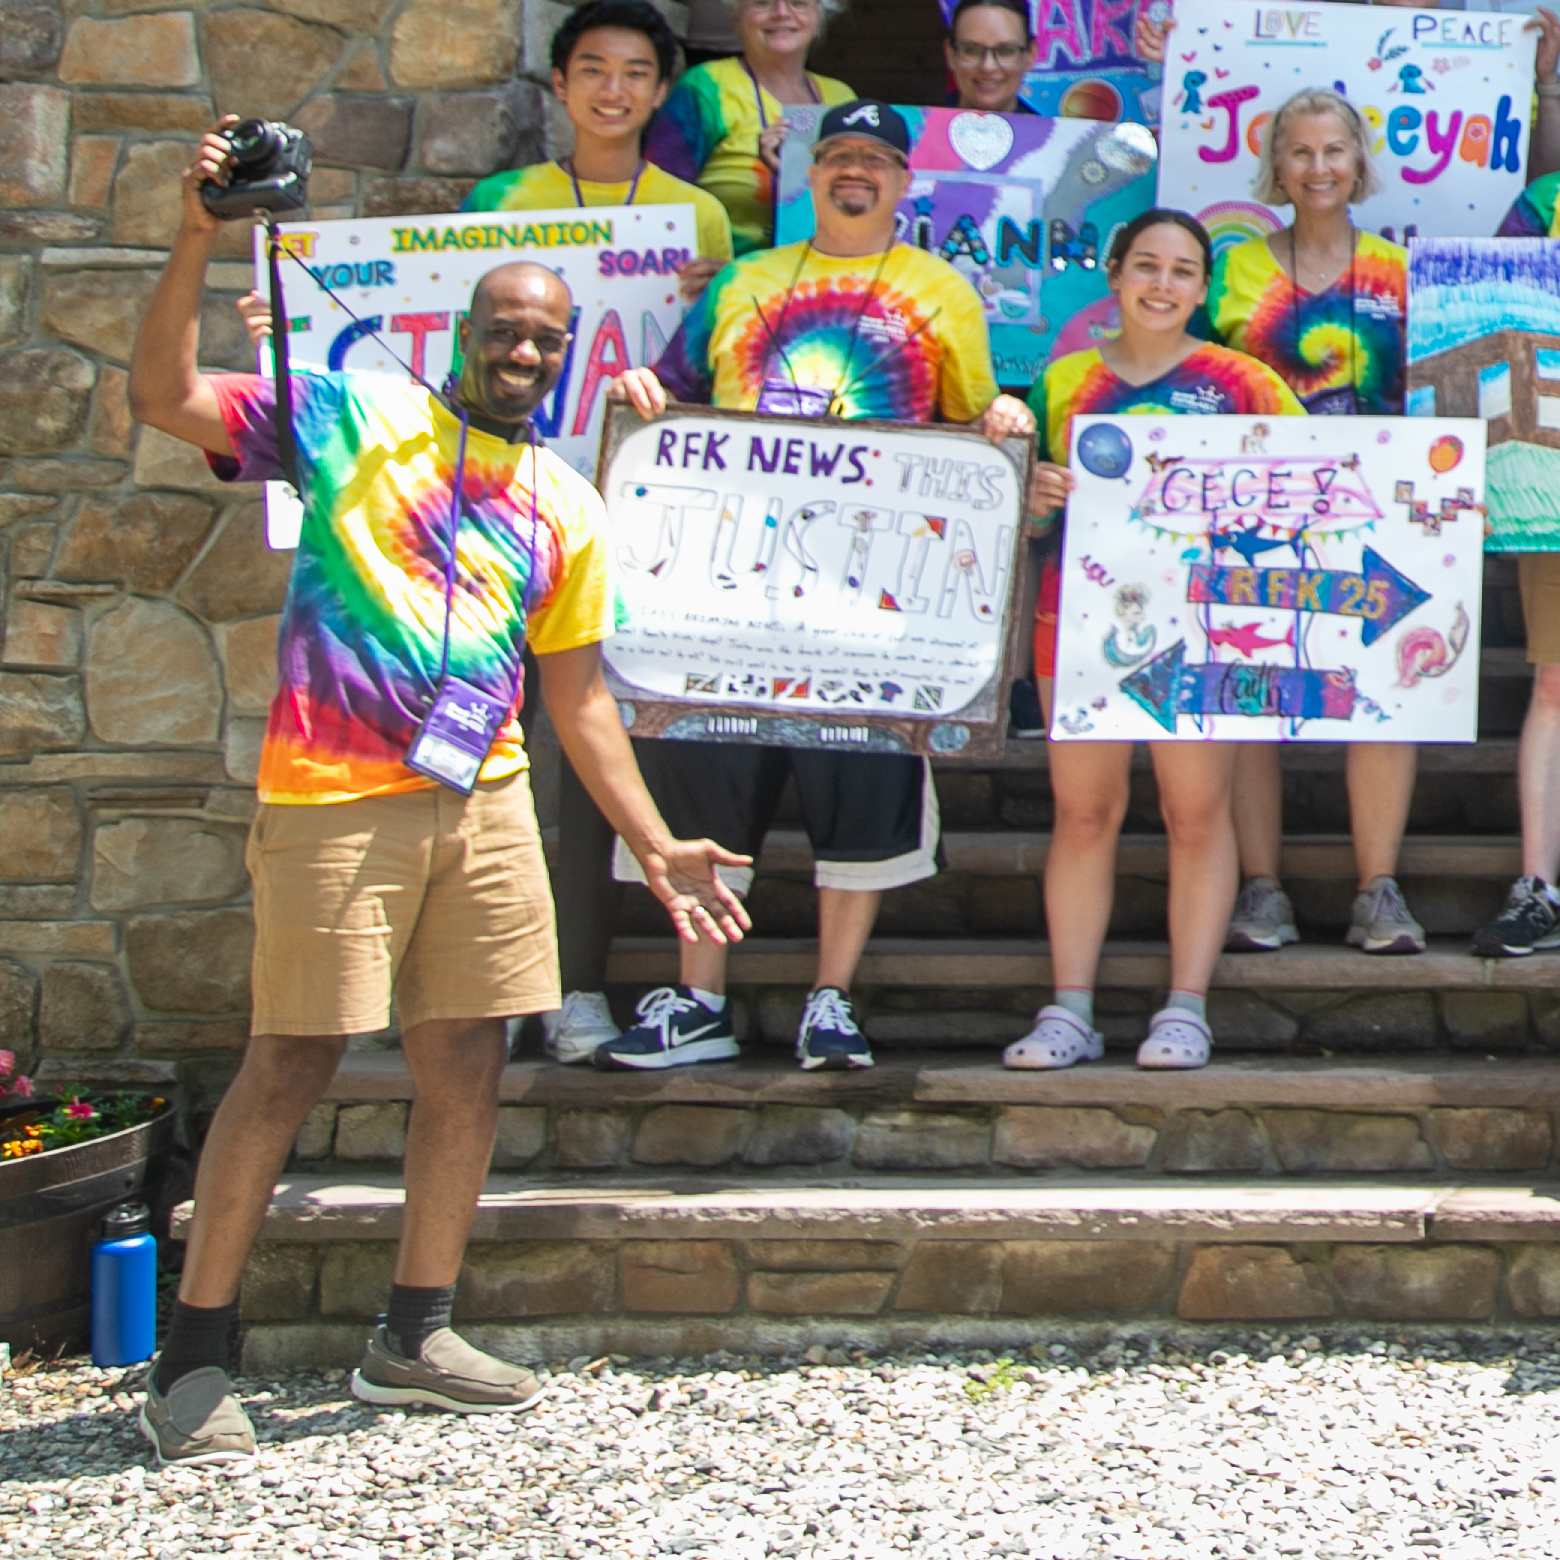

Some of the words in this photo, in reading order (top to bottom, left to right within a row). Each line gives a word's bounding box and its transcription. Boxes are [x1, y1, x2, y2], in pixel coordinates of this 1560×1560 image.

[1255, 9, 1322, 38] LOVE
[1412, 13, 1513, 47] PEACE
[391, 221, 613, 252] IMAGINATION
[312, 260, 396, 291] YOUR
[656, 428, 730, 471] RFK
[895, 451, 1008, 511] THIS
[615, 481, 1015, 624] JUSTIN
[1231, 569, 1325, 610] RFK
[1340, 577, 1389, 620] 25
